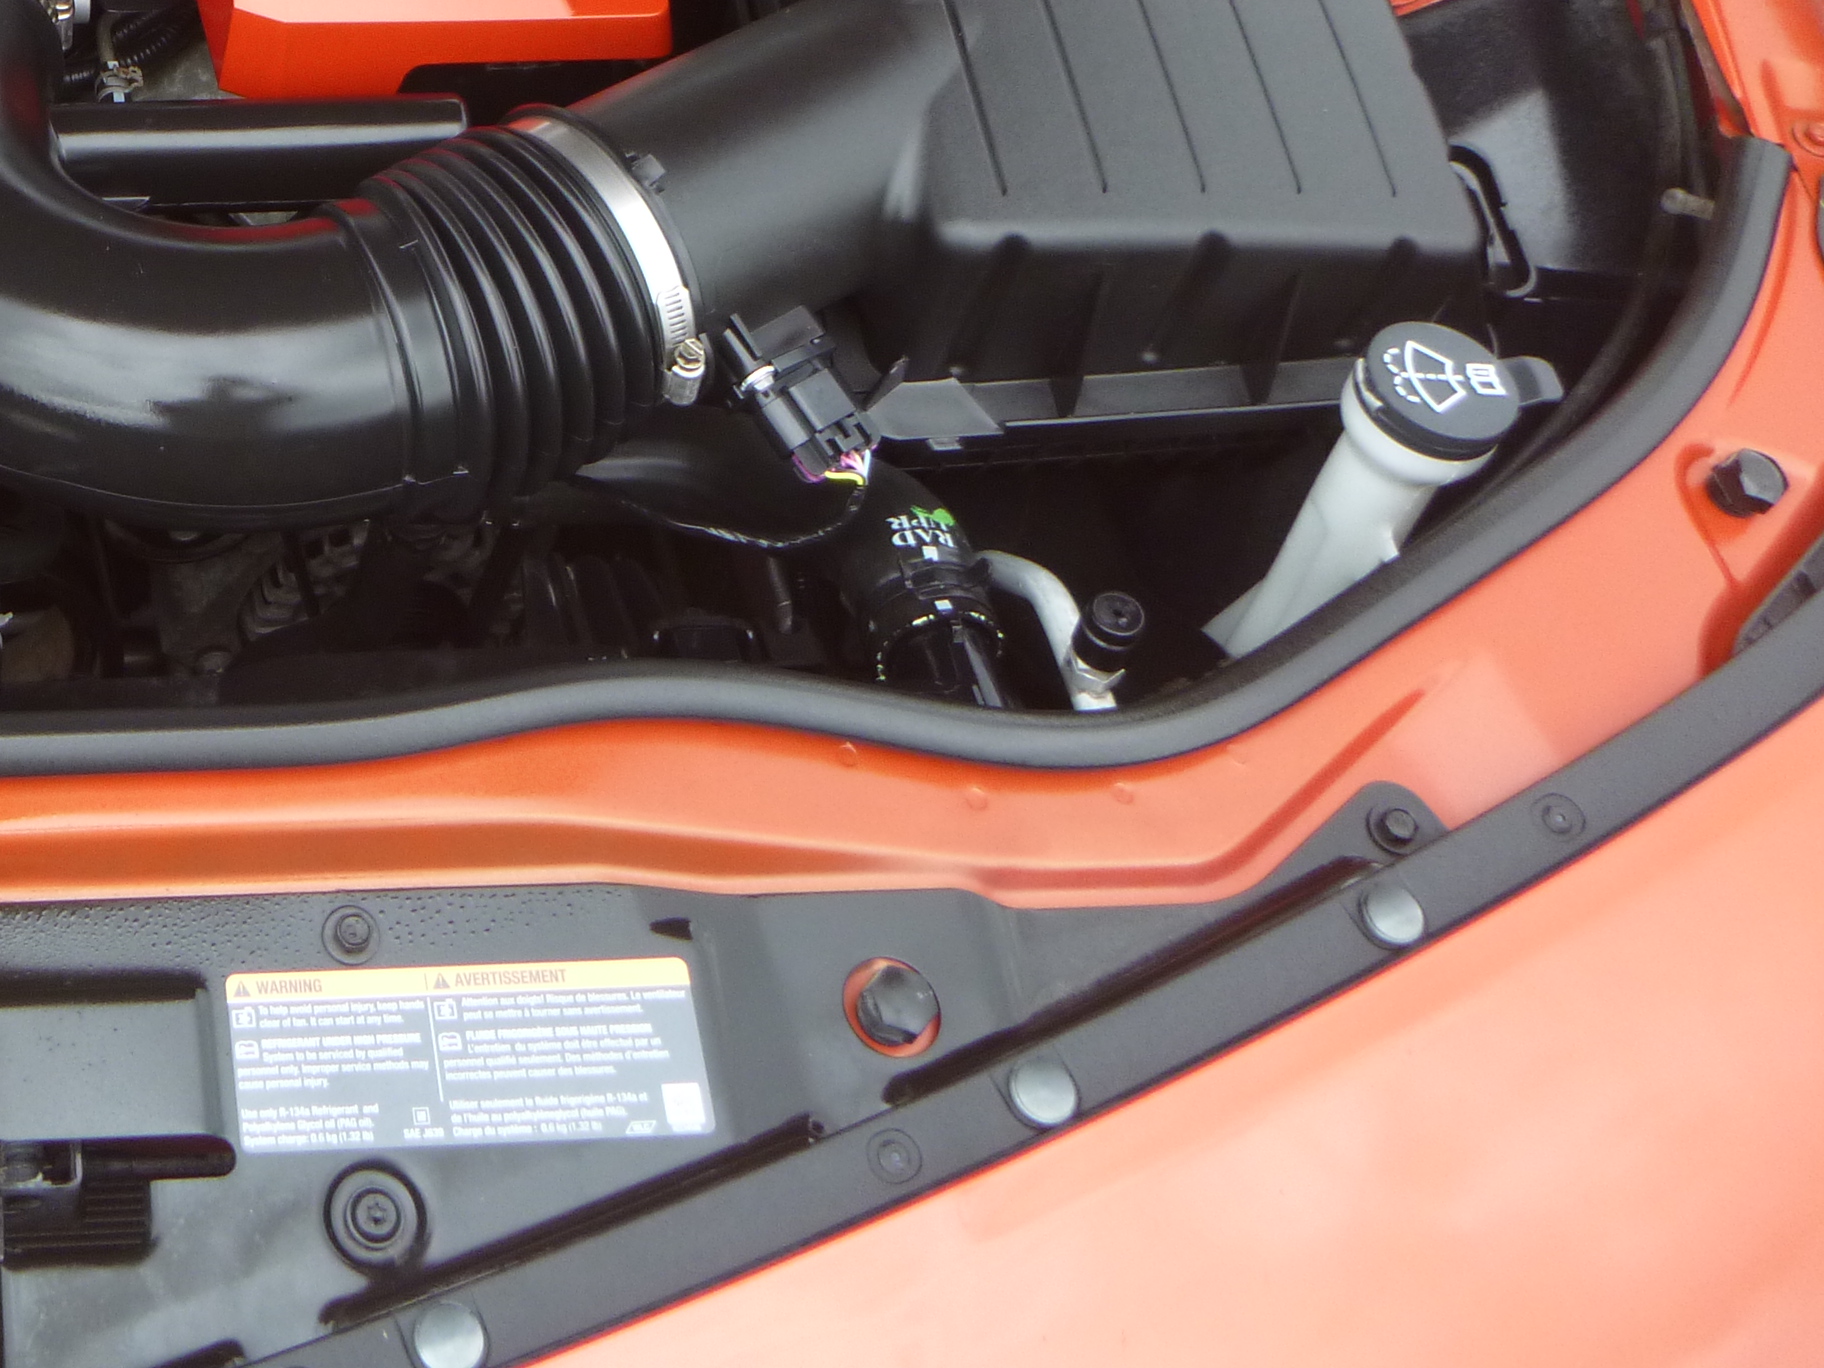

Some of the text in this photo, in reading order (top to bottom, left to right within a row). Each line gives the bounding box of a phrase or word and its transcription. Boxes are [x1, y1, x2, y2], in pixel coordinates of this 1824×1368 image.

[892, 529, 955, 548] RAD
[455, 969, 566, 987] AVERTISSEMENT
[256, 979, 322, 994] WARNING
[462, 996, 497, 1006] Attention
[500, 997, 515, 1005] aux
[546, 994, 573, 1005] Risque
[643, 990, 685, 1000] ventilateur
[270, 1004, 288, 1016] help
[289, 1004, 312, 1013] avoid
[313, 1002, 349, 1015] personal
[377, 1001, 397, 1012] keep
[399, 1000, 424, 1010] hands
[464, 1011, 481, 1021] peut
[496, 1010, 522, 1018] mettre
[531, 1008, 561, 1017] tourner
[259, 1018, 280, 1027] clear
[335, 1015, 354, 1025] start
[367, 1016, 382, 1025] any
[384, 1014, 403, 1023] time.
[261, 1033, 421, 1049] REFRIGERANT UNDER HIGH PRESSURE
[564, 1040, 579, 1049] doit
[635, 1040, 648, 1049] par
[263, 1052, 294, 1064] System
[318, 1050, 354, 1060] serviced
[367, 1048, 403, 1060] qualified
[444, 1058, 484, 1069] personnel
[566, 1054, 581, 1063] Des
[301, 1064, 339, 1075] Improper
[341, 1063, 371, 1072] service
[373, 1062, 409, 1071] methods
[411, 1063, 428, 1071] may
[445, 1070, 492, 1080] incorrectes
[529, 1069, 556, 1077] causer
[558, 1067, 573, 1076] des
[266, 1079, 302, 1090] personal
[450, 1100, 478, 1110] Utiliser
[480, 1098, 524, 1109] seulement
[535, 1097, 559, 1106] fluide
[607, 1093, 637, 1103] R-134a
[241, 1104, 379, 1119] Use only R-134a Refrigerant and
[297, 1119, 323, 1131] Glycol
[325, 1119, 335, 1128] oil
[337, 1118, 357, 1130] (PAG
[454, 1127, 483, 1138] Charge
[541, 1124, 554, 1132] 0.6
[569, 1122, 589, 1133] (1.32
[244, 1136, 276, 1147] System
[311, 1134, 324, 1143] 0.6
[339, 1132, 361, 1144] (1.32
[404, 1129, 421, 1138] SAE
